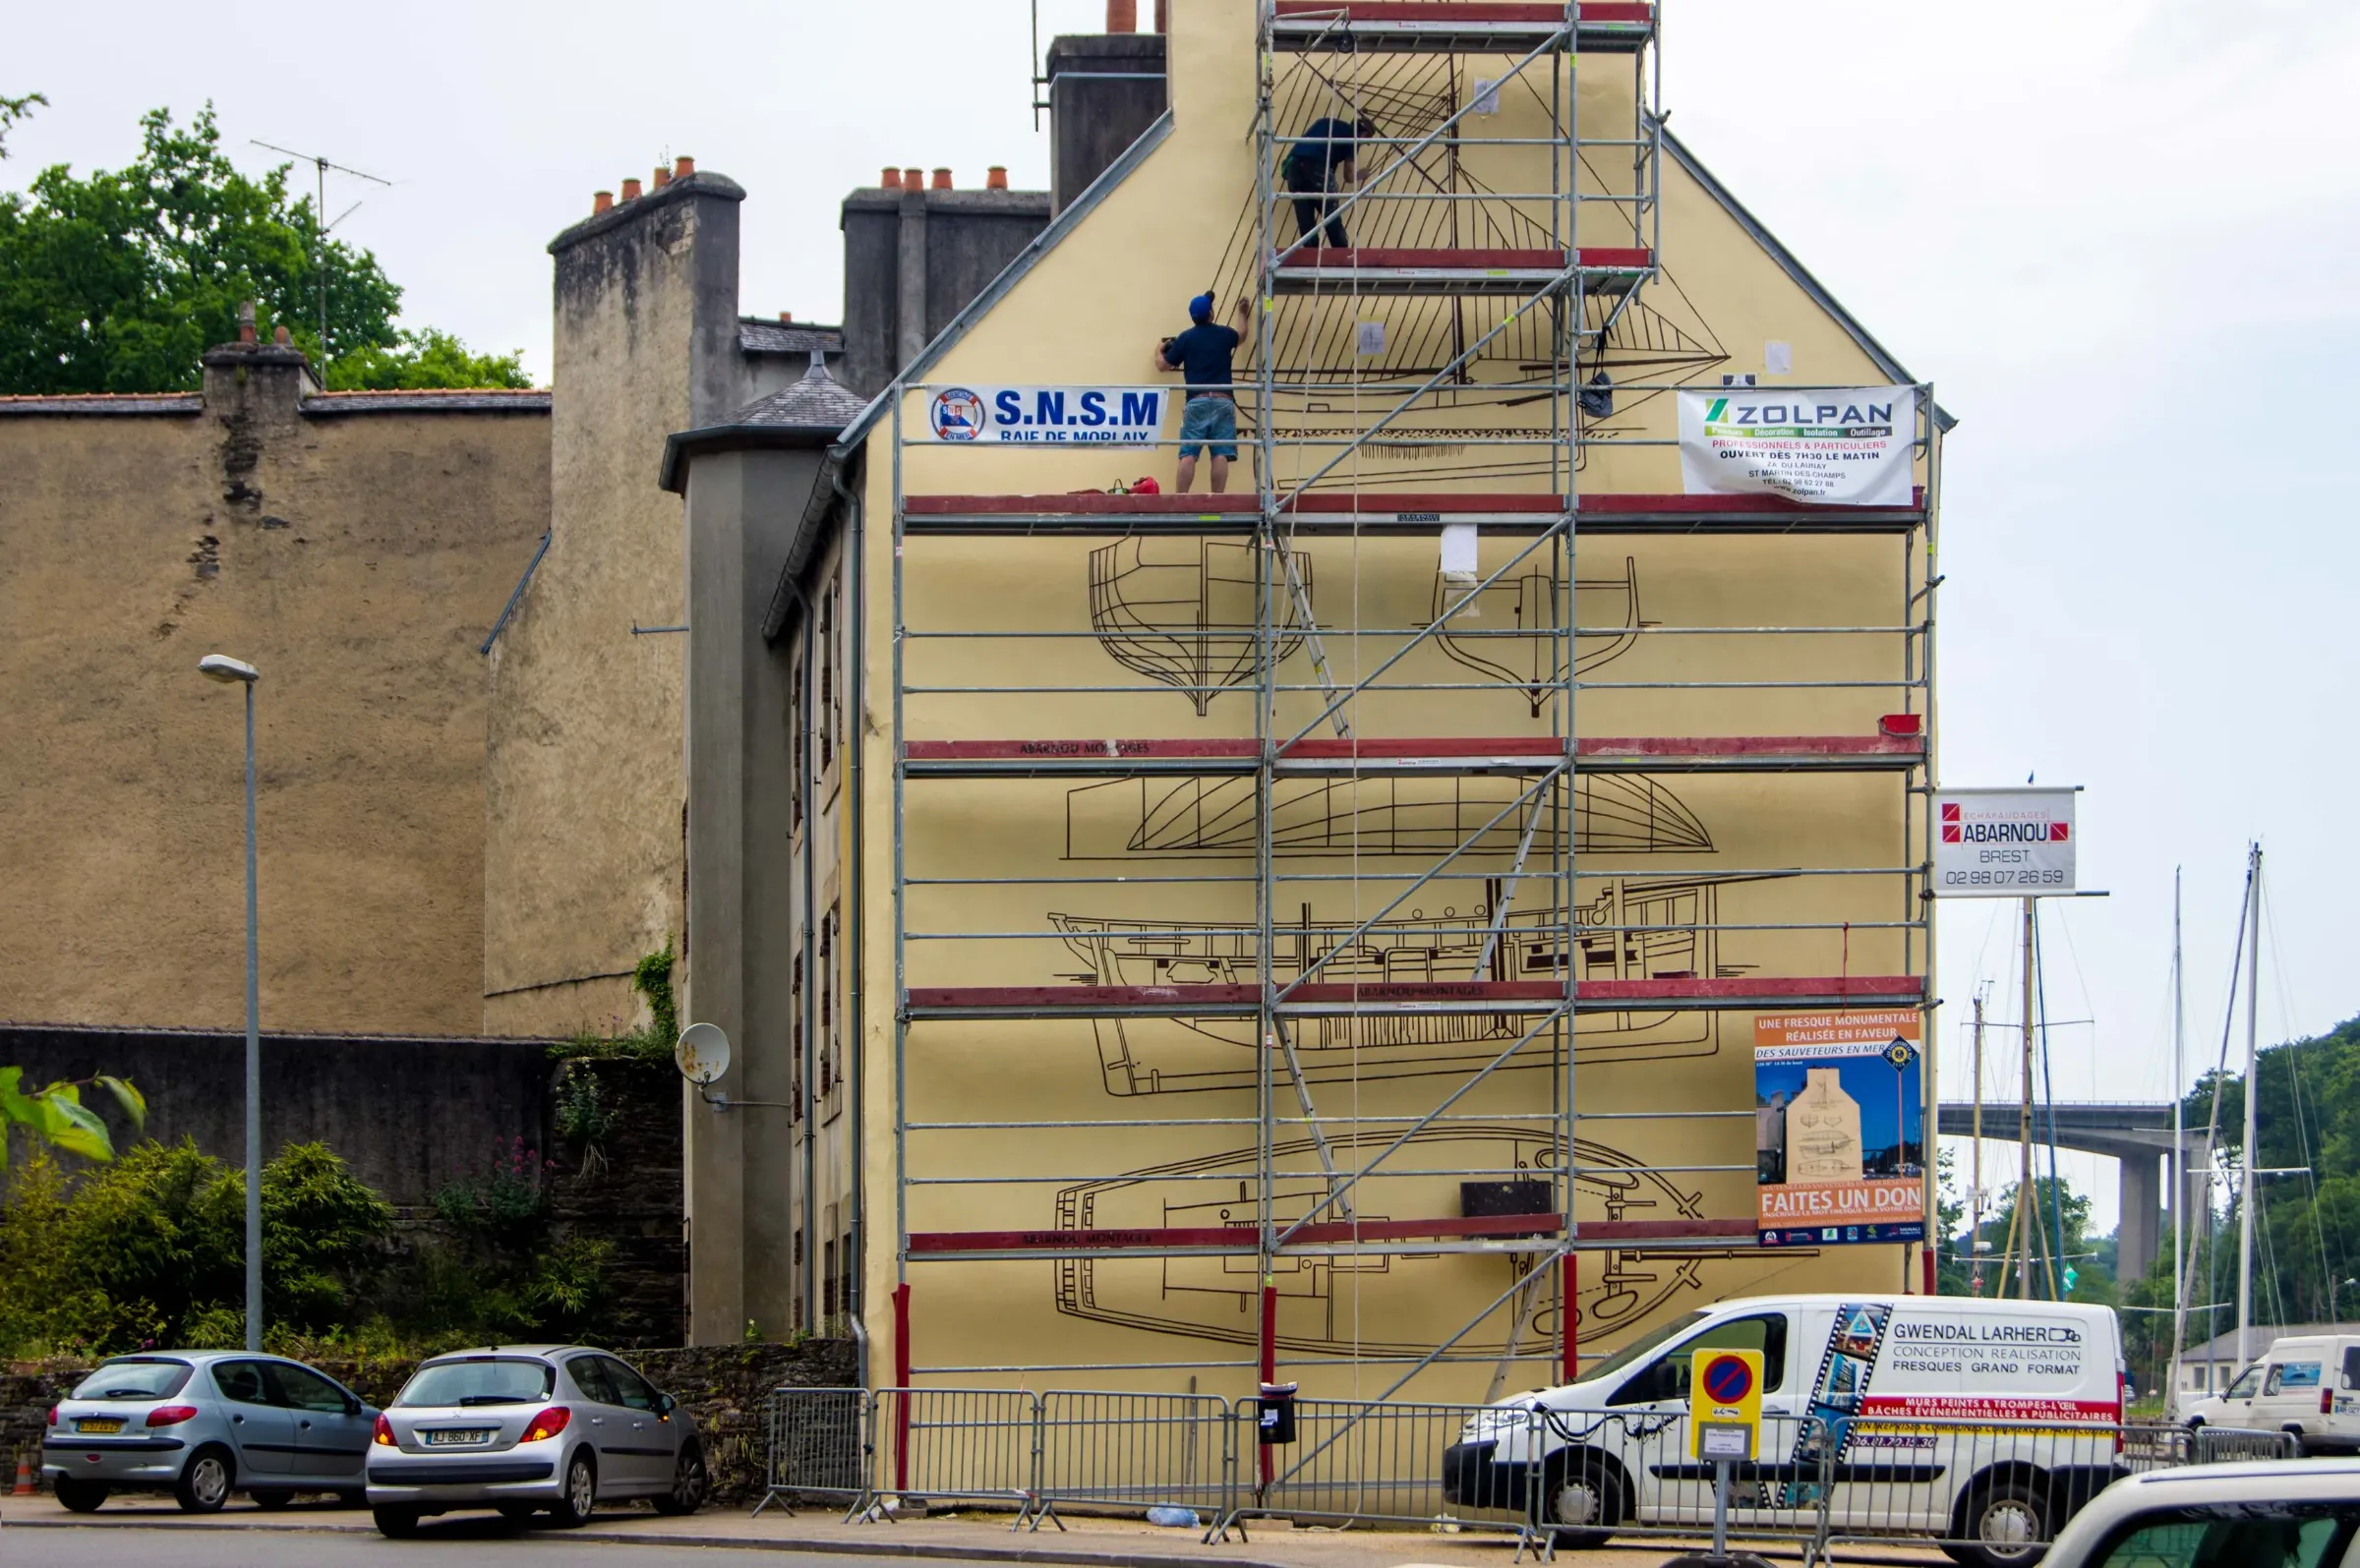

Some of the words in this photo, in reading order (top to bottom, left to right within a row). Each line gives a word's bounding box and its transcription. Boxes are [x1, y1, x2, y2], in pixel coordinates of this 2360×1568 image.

[995, 390, 1158, 426] S.N.S.M
[1737, 403, 1892, 425] ZOLPAN
[1754, 428, 1795, 436] Décoration
[1850, 428, 1886, 437] Outillage
[1712, 439, 1801, 449] PROFESSIONNELS
[1814, 440, 1887, 450] PARTICULIERS
[1769, 450, 1791, 459] DÈS
[1963, 822, 2047, 842] ABARNOU
[1979, 849, 2031, 863] BREST
[1946, 871, 1967, 885] 02
[1970, 871, 1991, 885] 98
[1994, 871, 2015, 884] 07
[2018, 870, 2039, 884] 26
[2042, 870, 2063, 883] 59
[1758, 1017, 1782, 1029] UNE
[1784, 1016, 1832, 1028] FRESQUE
[1835, 1013, 1918, 1025] MONUMENTALE
[1786, 1028, 1836, 1041] RÉALISÉE
[1838, 1029, 1852, 1039] EN
[1856, 1027, 1898, 1038] FAVEUR
[1756, 1049, 1775, 1059] DES
[1778, 1045, 1844, 1057] SAUVETEURS
[1847, 1045, 1860, 1054] EN
[1863, 1043, 1885, 1053] MER
[1761, 1190, 1833, 1212] FAITES
[1838, 1189, 1868, 1209] UN
[1874, 1187, 1921, 1207] DON
[1894, 1324, 1976, 1340] GWENDAL
[1981, 1326, 2046, 1341] LARHER
[1893, 1346, 1983, 1359] CONCEPTION
[1991, 1348, 2081, 1361] REALISATION
[1893, 1361, 1962, 1371] FRESQUES
[1971, 1362, 2018, 1373] GRAND
[2028, 1364, 2080, 1374] FORMAT
[1906, 1398, 1937, 1407] MURS
[1940, 1398, 1979, 1407] PEINTS
[1867, 1405, 1912, 1416] BÂCHES
[1915, 1406, 2017, 1418] ÉVÉNEMENTIELLES
[2032, 1410, 2113, 1421] PUBLICITAIRES
